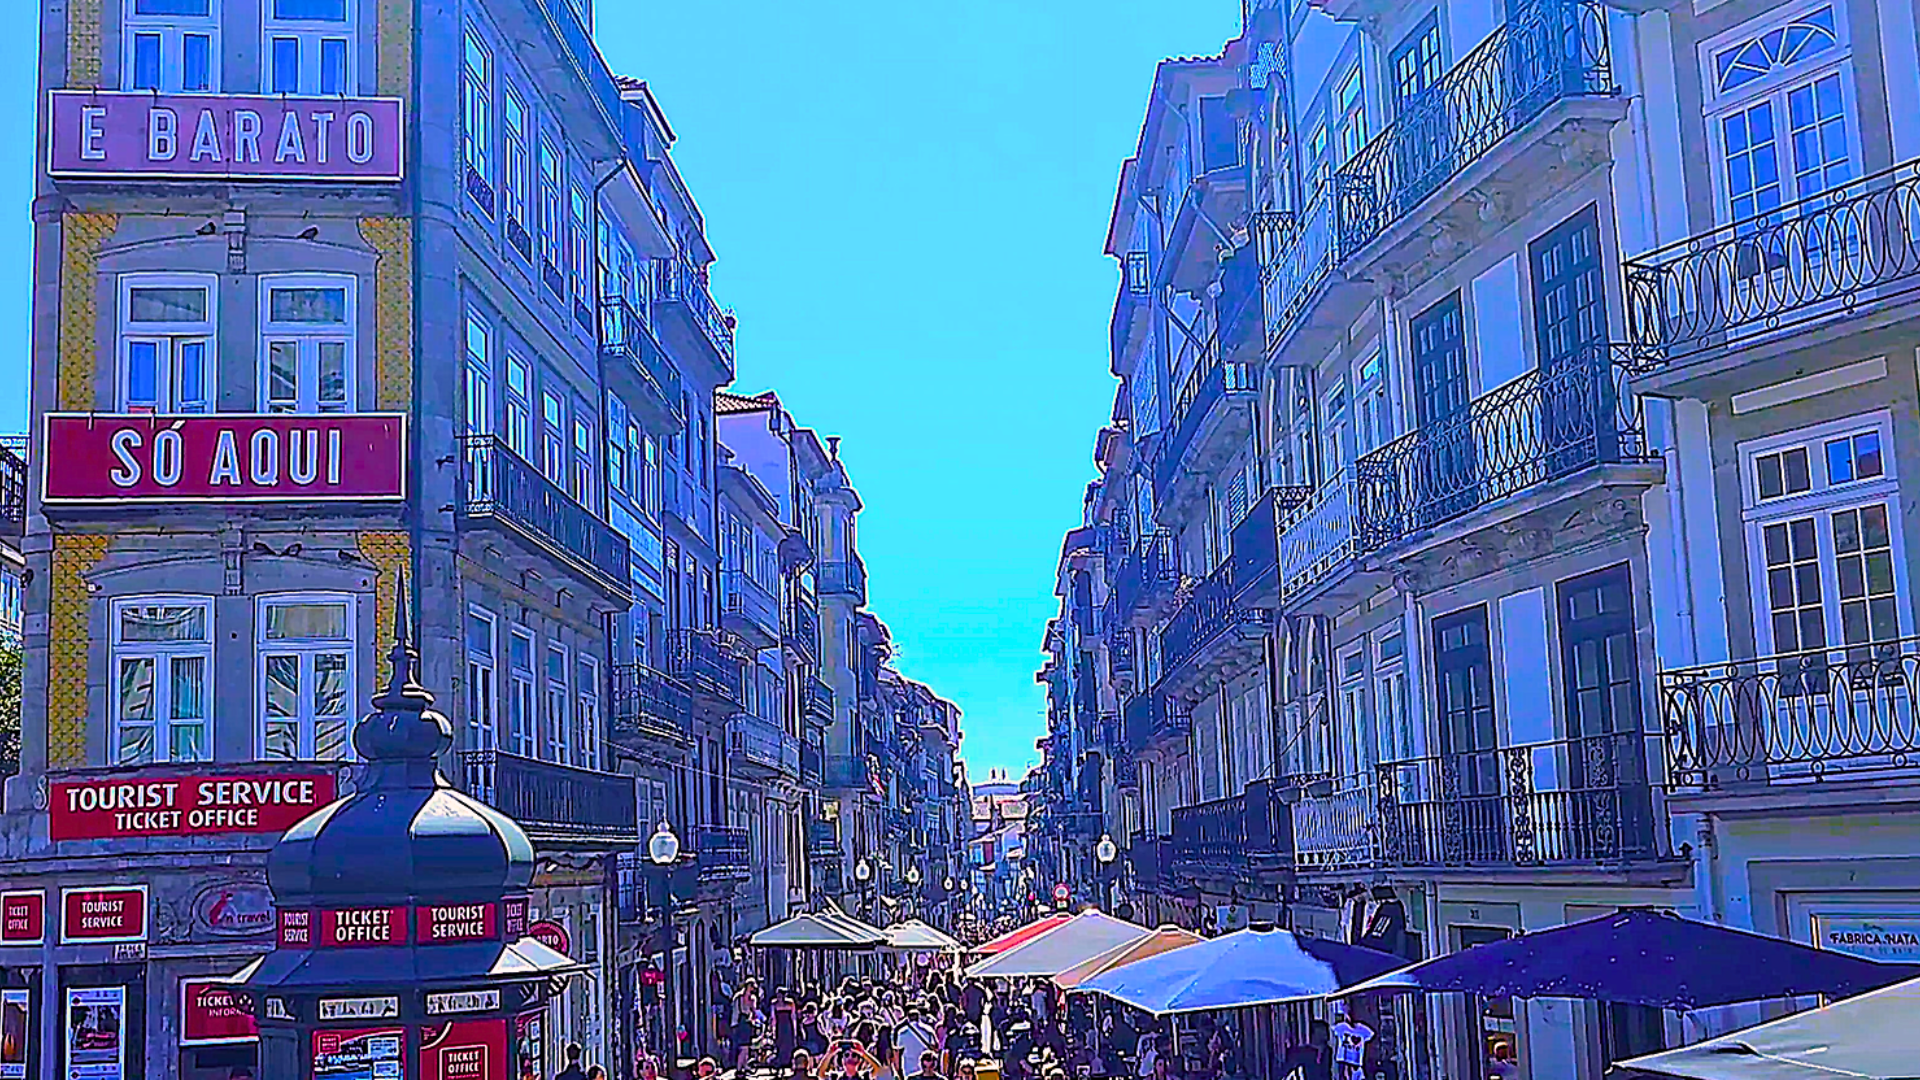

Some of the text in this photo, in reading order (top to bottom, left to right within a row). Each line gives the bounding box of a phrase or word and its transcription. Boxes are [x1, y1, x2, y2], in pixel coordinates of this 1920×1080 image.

[81, 106, 374, 164] E BARATO
[110, 419, 342, 487] SÓ AQUI
[66, 780, 314, 812] TOURIST SERVICE
[115, 808, 258, 831] TICKET OFFICE
[81, 900, 124, 914] TOURIST
[431, 905, 485, 922] TOURIST
[81, 915, 123, 929] SERVICE
[335, 909, 390, 925] TICKET
[335, 925, 390, 942] OFFICE
[432, 921, 485, 939] SERVICE
[447, 1050, 480, 1063] TICKET
[447, 1061, 480, 1074] OFFICE
